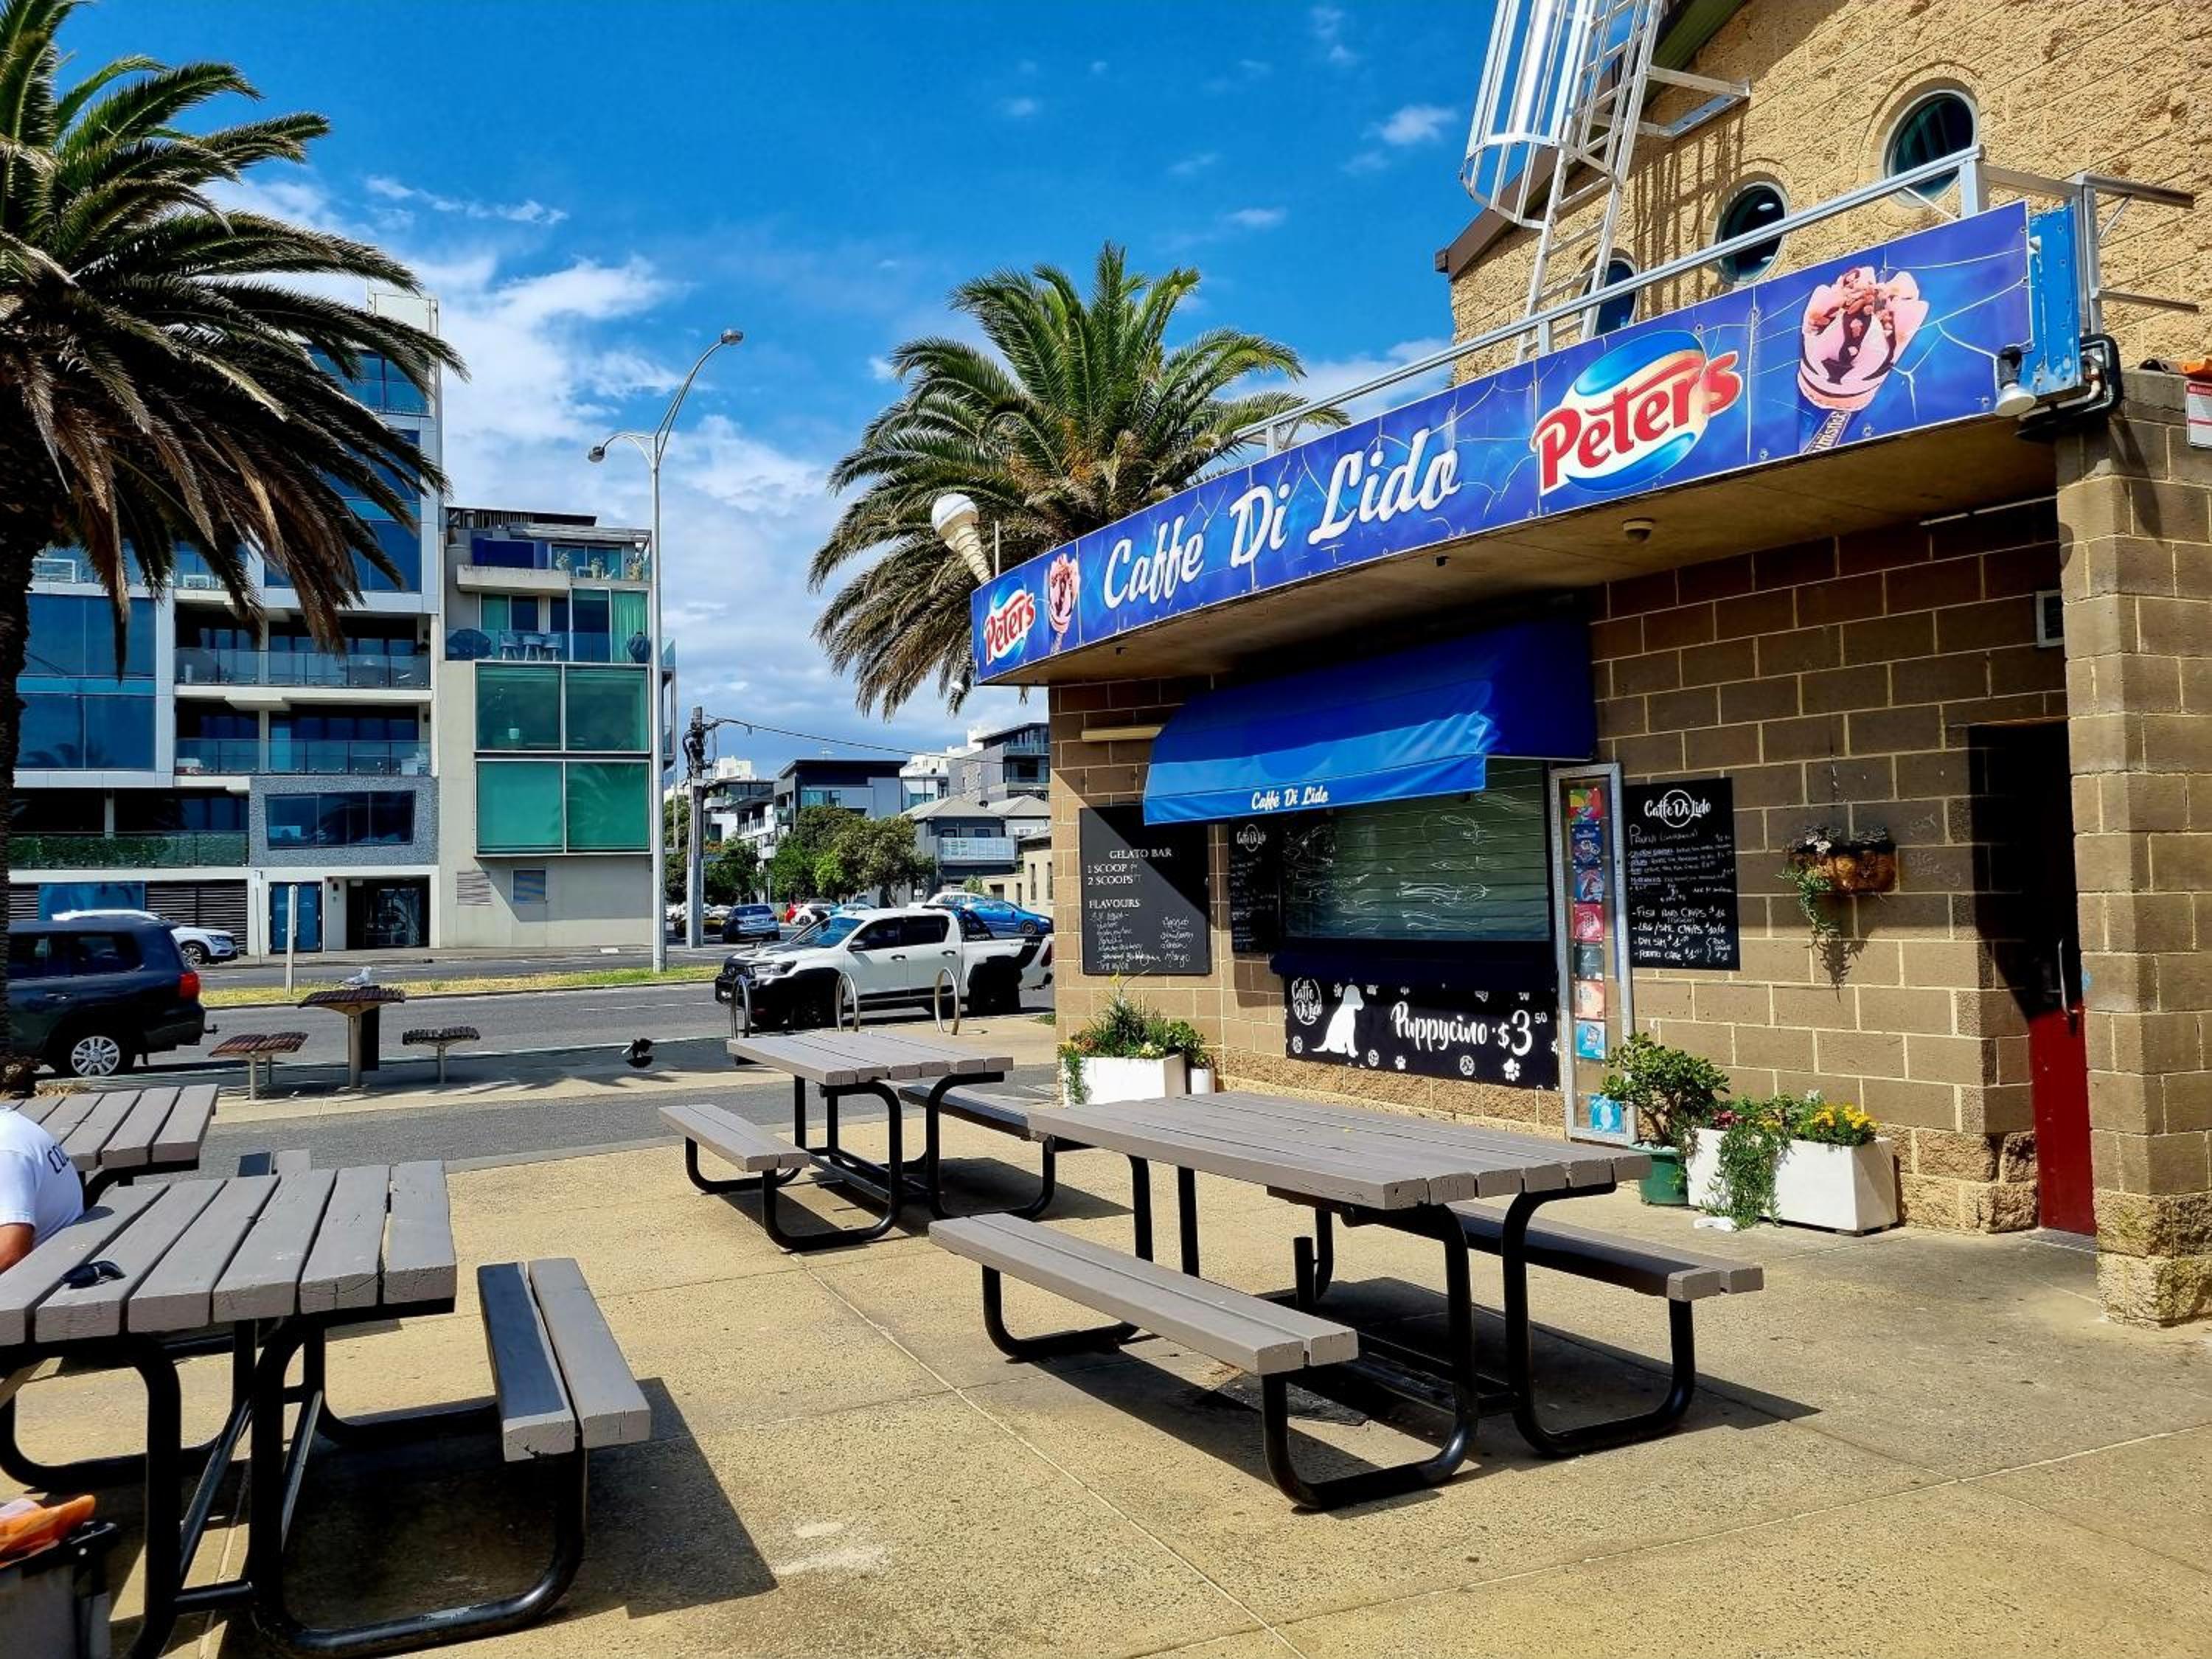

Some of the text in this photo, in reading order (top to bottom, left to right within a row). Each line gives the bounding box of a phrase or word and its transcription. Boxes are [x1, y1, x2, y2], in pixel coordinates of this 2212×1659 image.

[1533, 351, 1742, 493] Peters
[1229, 483, 1290, 568] Di
[1308, 428, 1461, 545] Lido
[984, 593, 1034, 664] Peters
[1284, 788, 1298, 807] Di
[1301, 785, 1329, 805] Lido
[1644, 798, 1711, 818] Caffe Di Lido
[1109, 847, 1172, 859] GELATO BAR
[1093, 863, 1127, 874] SCOOP
[1088, 875, 1133, 886] 2 SCOOPS
[1089, 899, 1141, 909] FLAVOURS
[1390, 1001, 1487, 1052] Puppycino
